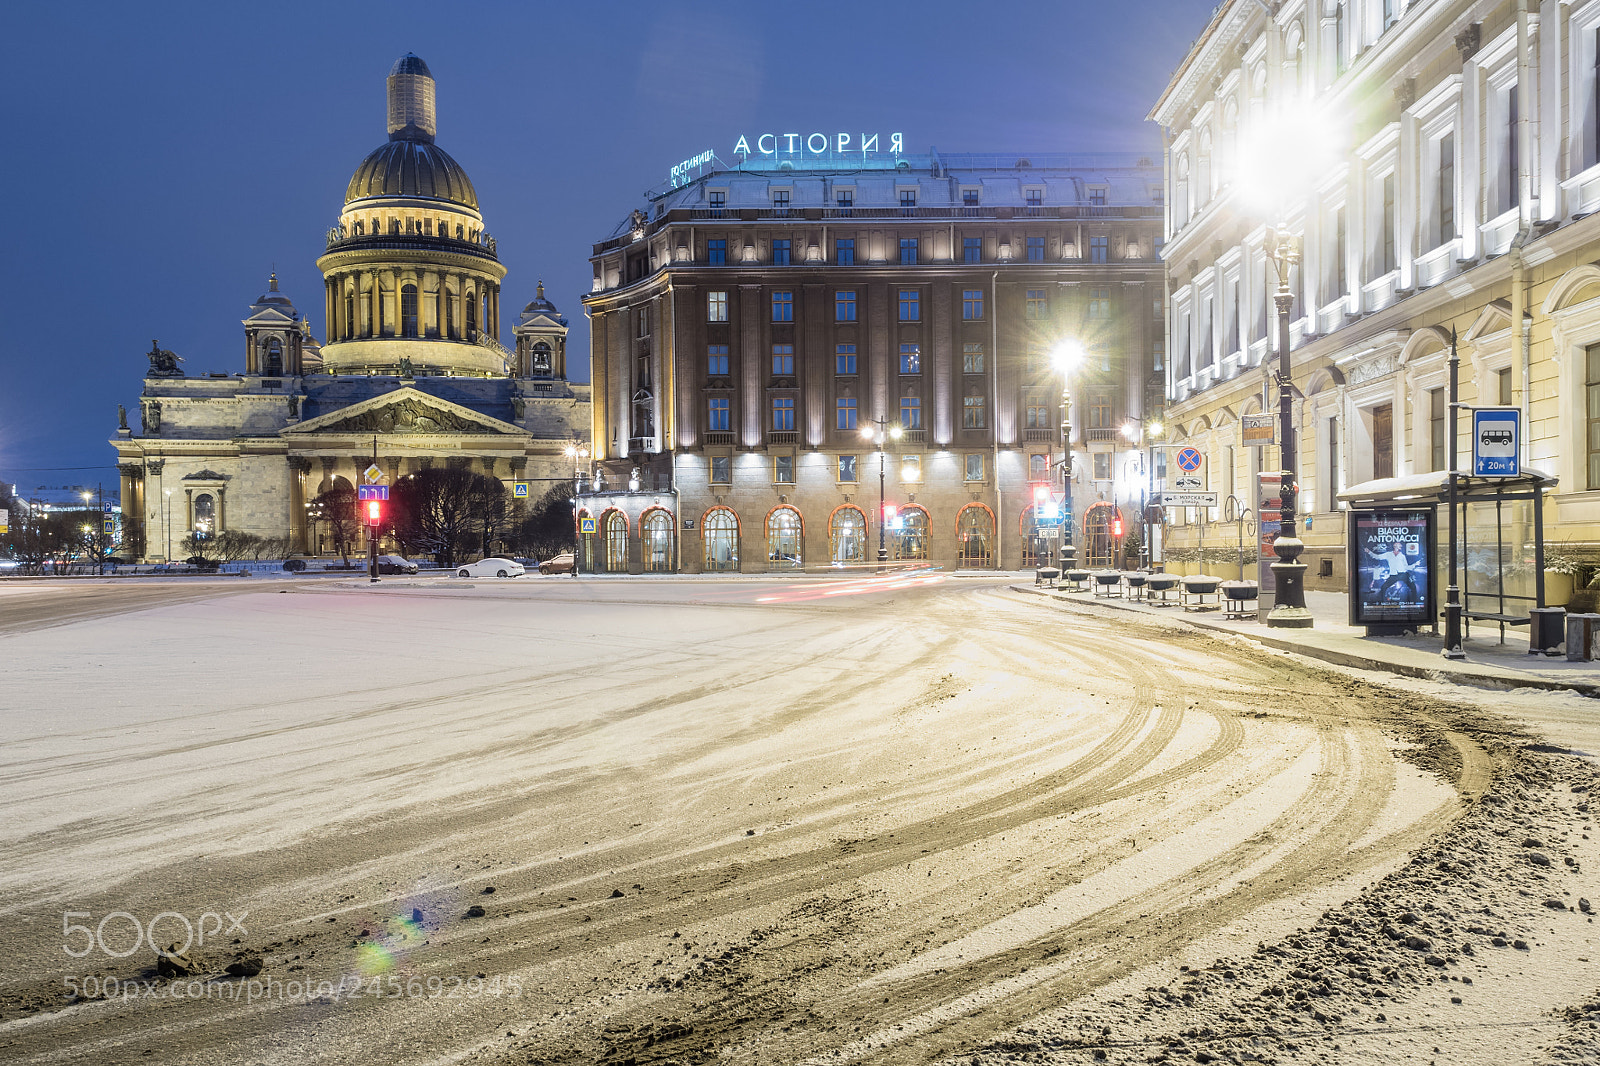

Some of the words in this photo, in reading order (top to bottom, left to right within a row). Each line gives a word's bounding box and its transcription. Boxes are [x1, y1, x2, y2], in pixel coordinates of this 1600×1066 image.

[733, 132, 903, 154] АСТОРИЯ
[671, 148, 715, 177] ГОСТИНИЦА
[1378, 527, 1409, 535] BIAGIO
[1367, 535, 1420, 543] ANTONACCI
